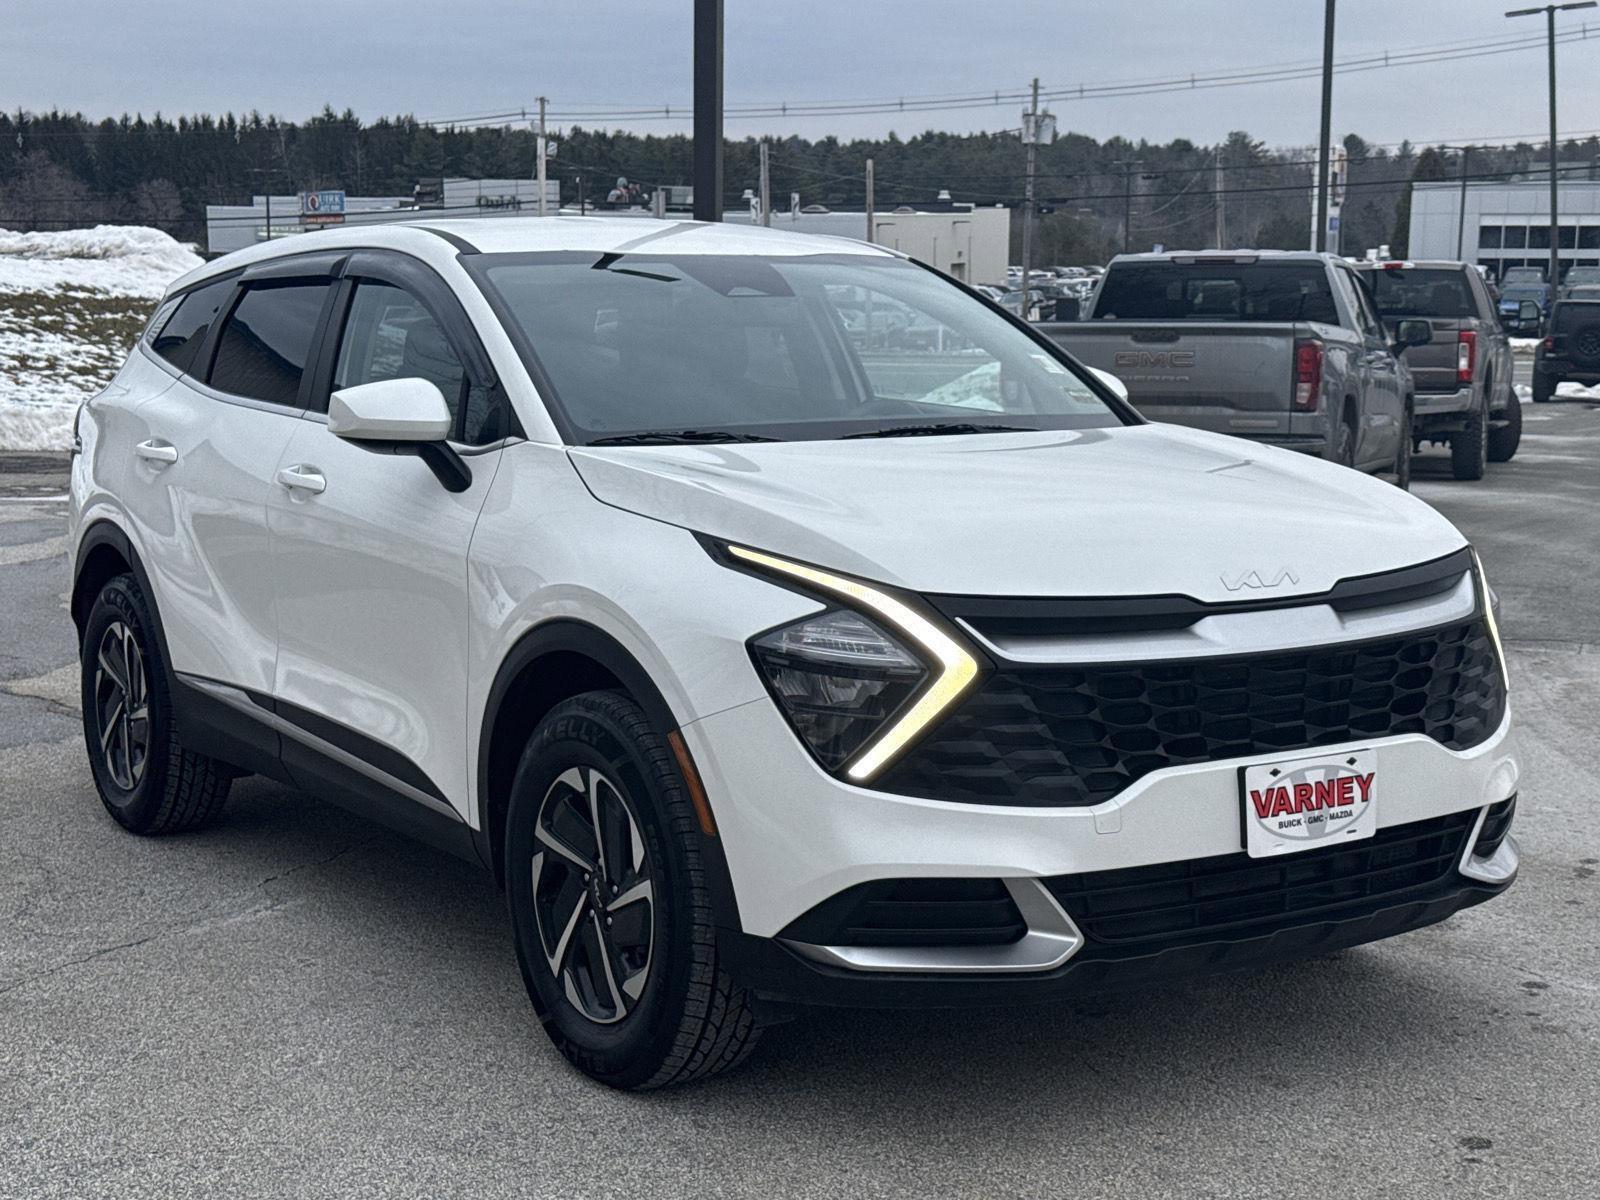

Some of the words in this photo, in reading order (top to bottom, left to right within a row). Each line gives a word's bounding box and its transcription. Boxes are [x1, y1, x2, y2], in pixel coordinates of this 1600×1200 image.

[1115, 351, 1194, 368] GMC
[1250, 772, 1375, 819] VARNEY
[1278, 818, 1302, 829] BUICK
[1308, 814, 1324, 824] GMC
[1329, 810, 1353, 821] MAZDA
